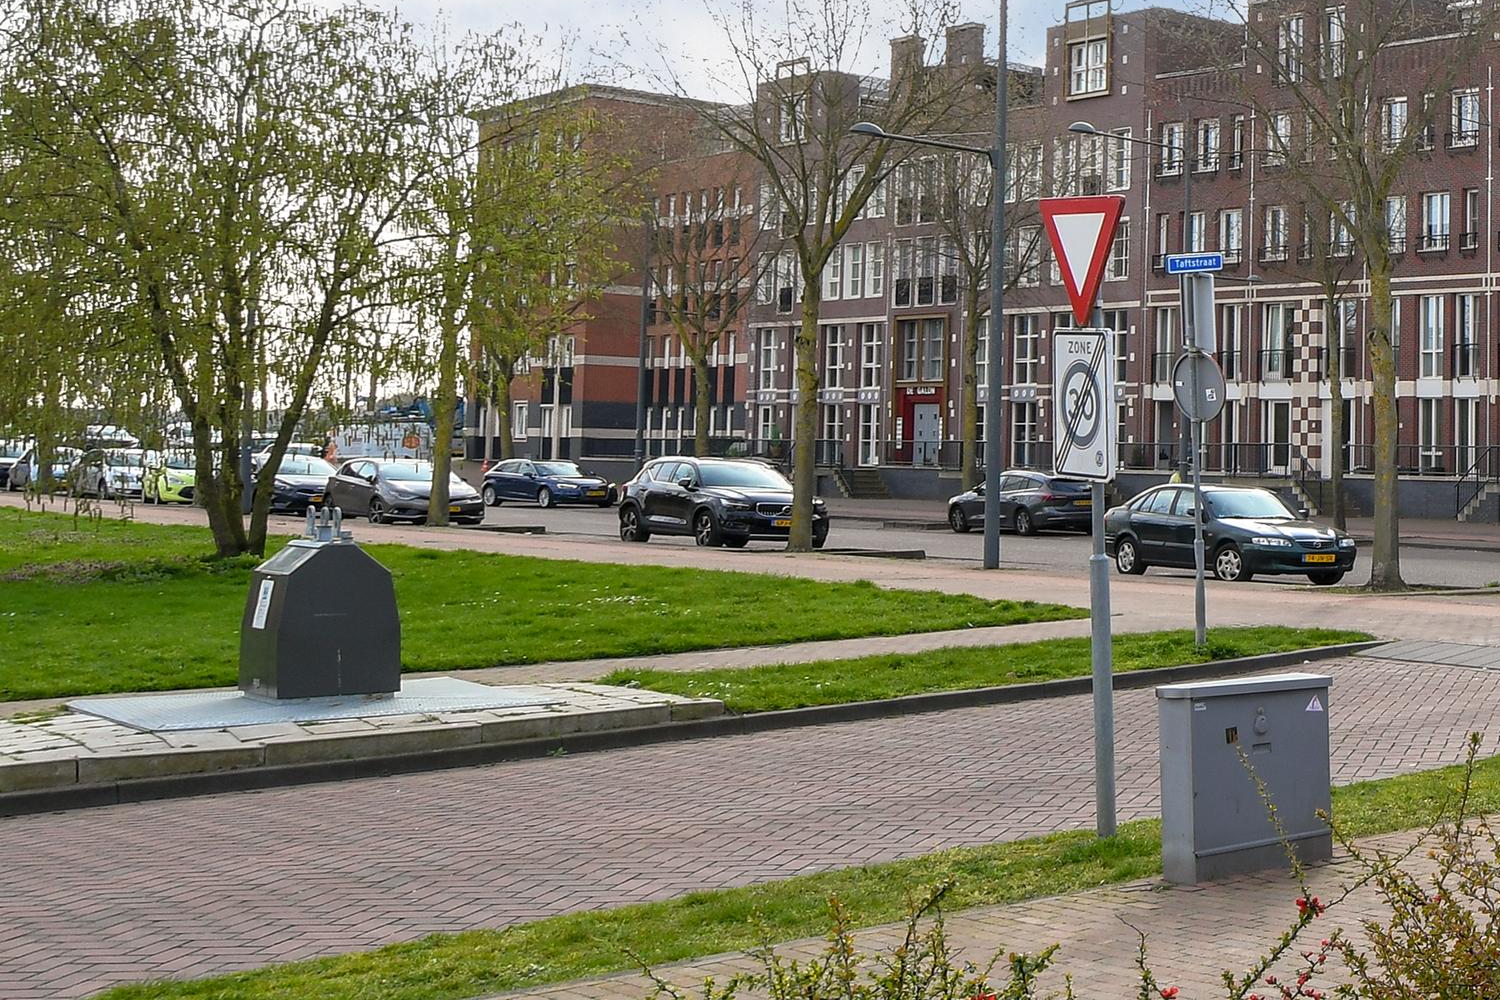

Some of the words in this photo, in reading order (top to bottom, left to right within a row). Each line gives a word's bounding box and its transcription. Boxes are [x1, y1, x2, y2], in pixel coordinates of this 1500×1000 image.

[1175, 258, 1216, 268] Taftstraat
[1068, 340, 1092, 354] ZONE
[1068, 388, 1094, 420] 30
